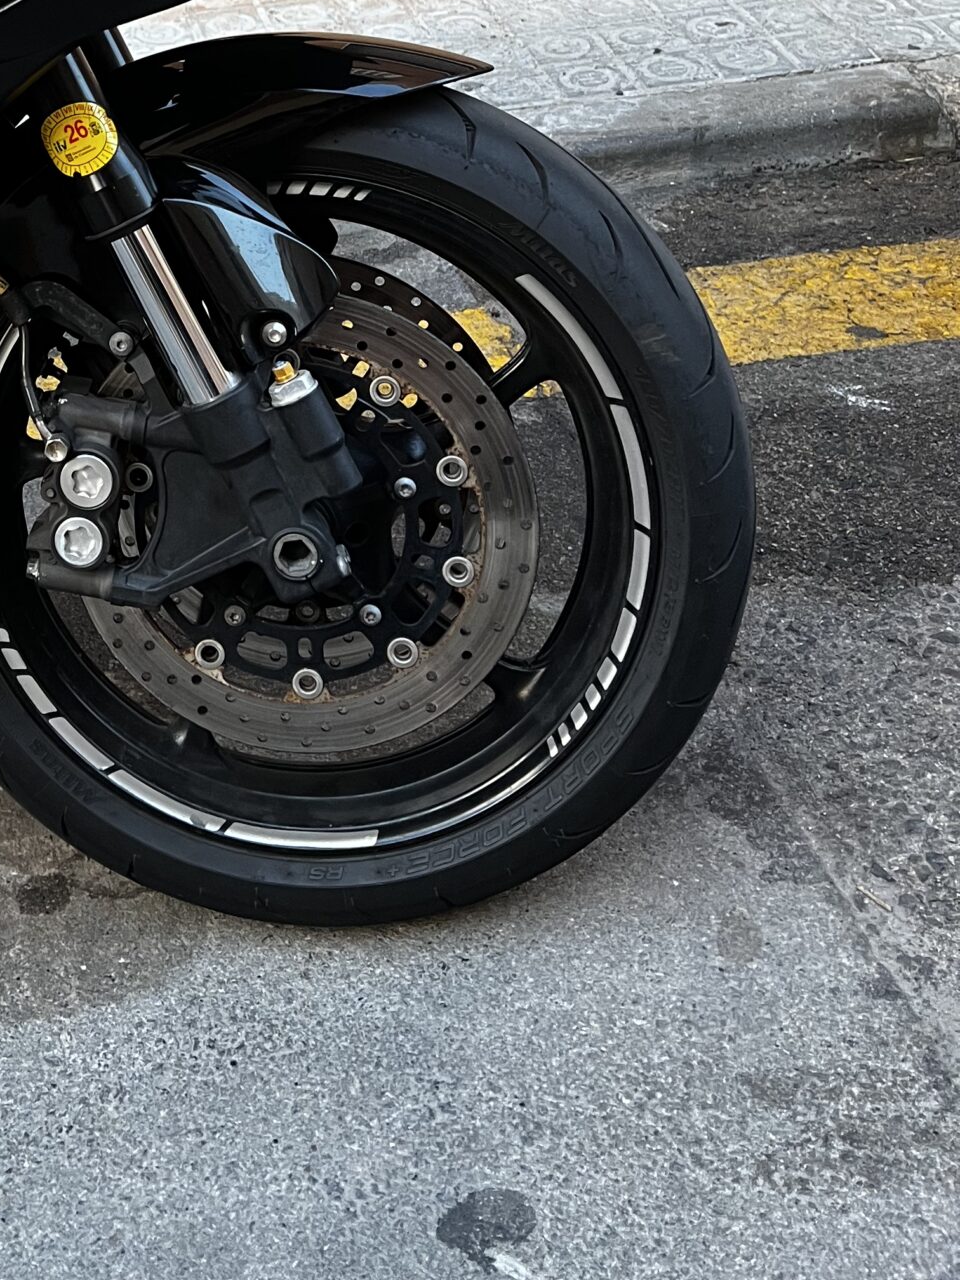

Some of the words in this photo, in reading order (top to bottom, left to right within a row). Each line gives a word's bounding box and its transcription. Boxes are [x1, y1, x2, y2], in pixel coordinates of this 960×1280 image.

[63, 119, 89, 144] 26
[544, 705, 635, 812] SPORT
[309, 865, 344, 881] RS
